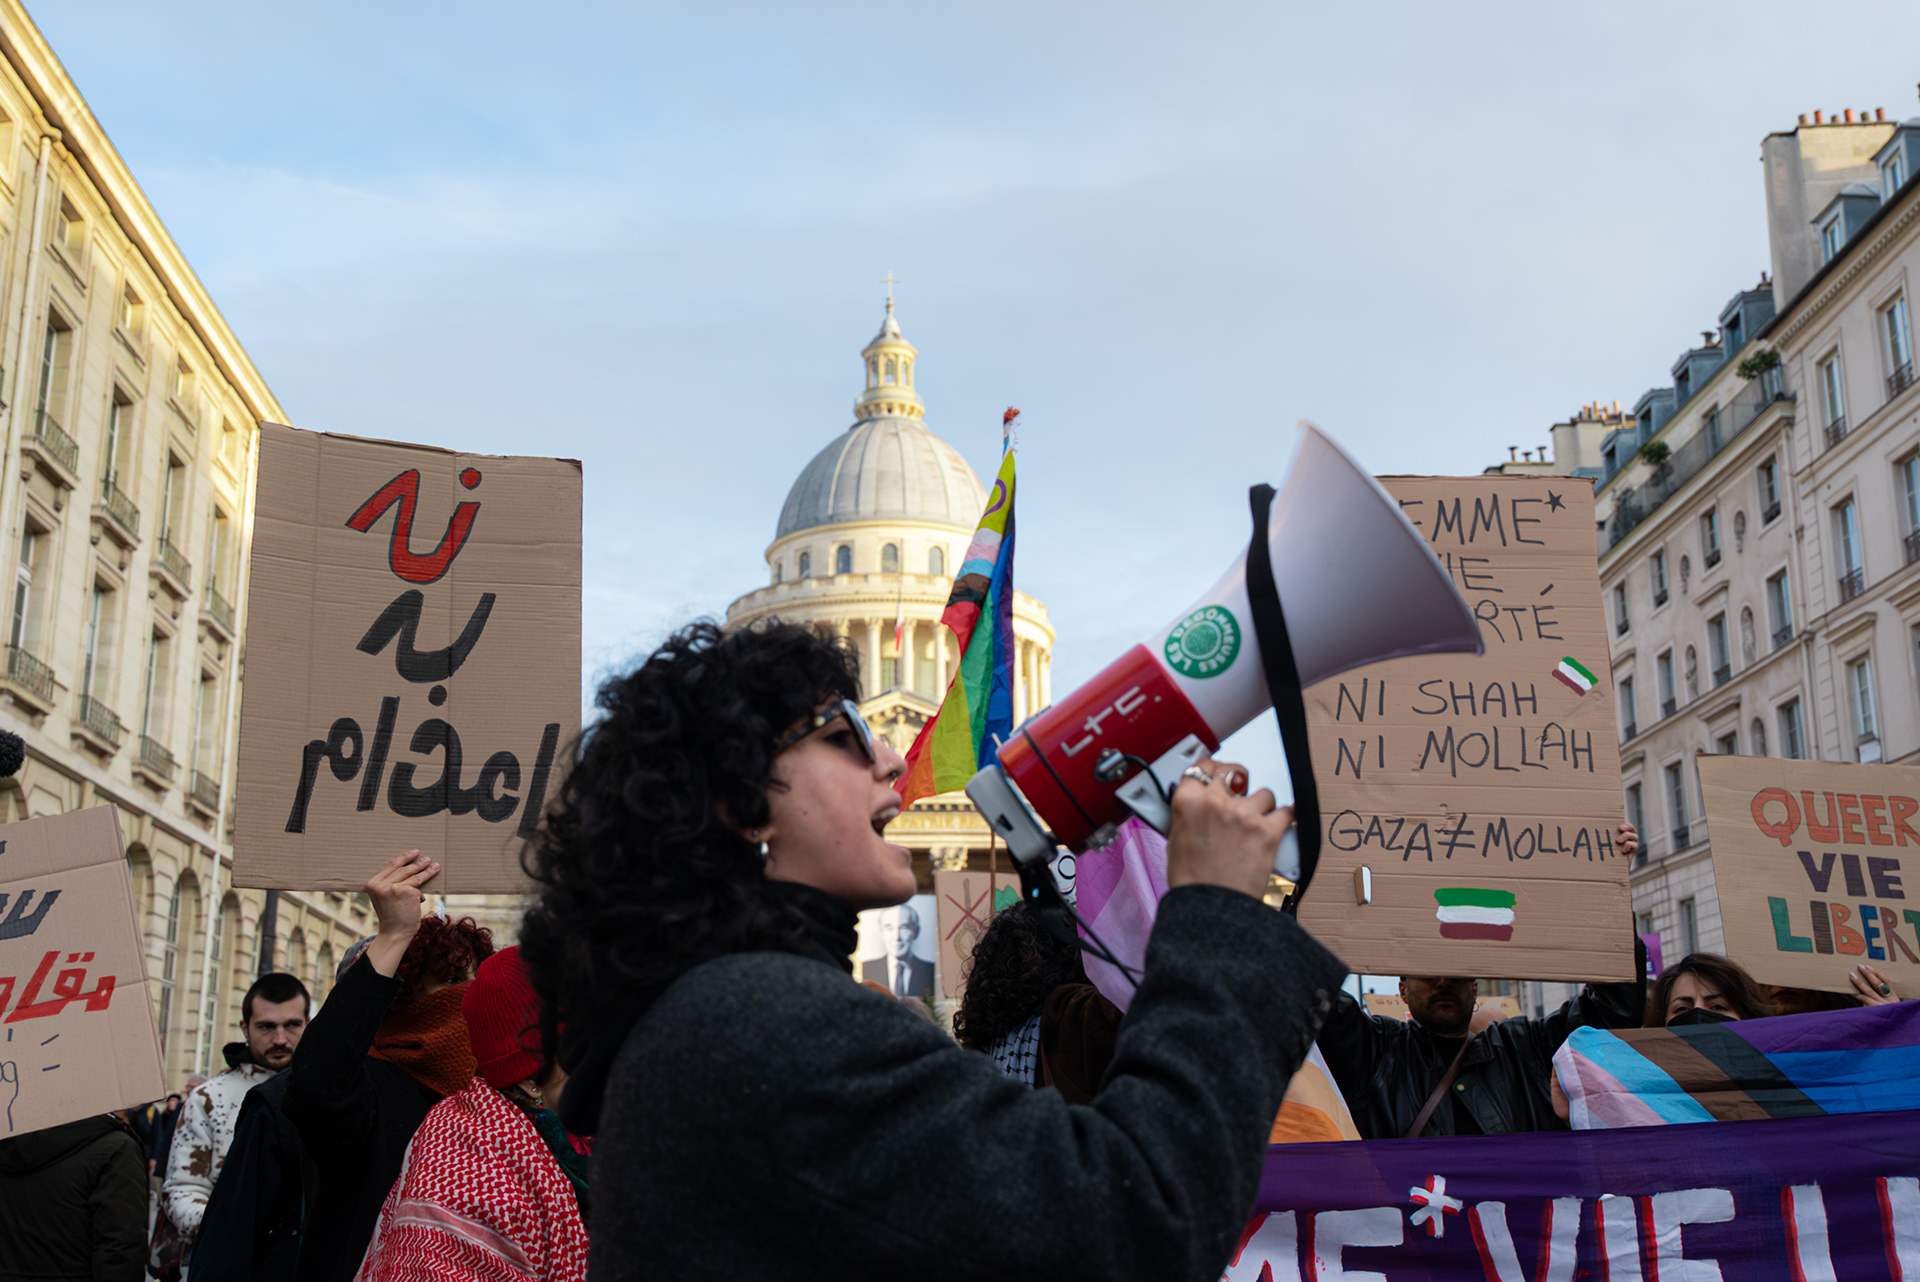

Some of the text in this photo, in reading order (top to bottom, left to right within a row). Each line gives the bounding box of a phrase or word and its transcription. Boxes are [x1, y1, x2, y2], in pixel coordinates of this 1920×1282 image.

[1437, 552, 1504, 593] IE
[1474, 583, 1564, 643] RTÉ
[1336, 678, 1537, 722] NI SHAH
[1335, 722, 1594, 779] NI MOLLAH
[1751, 787, 1920, 848] QUEER
[1797, 851, 1905, 899] VIE
[1767, 896, 1920, 964] LIBERT
